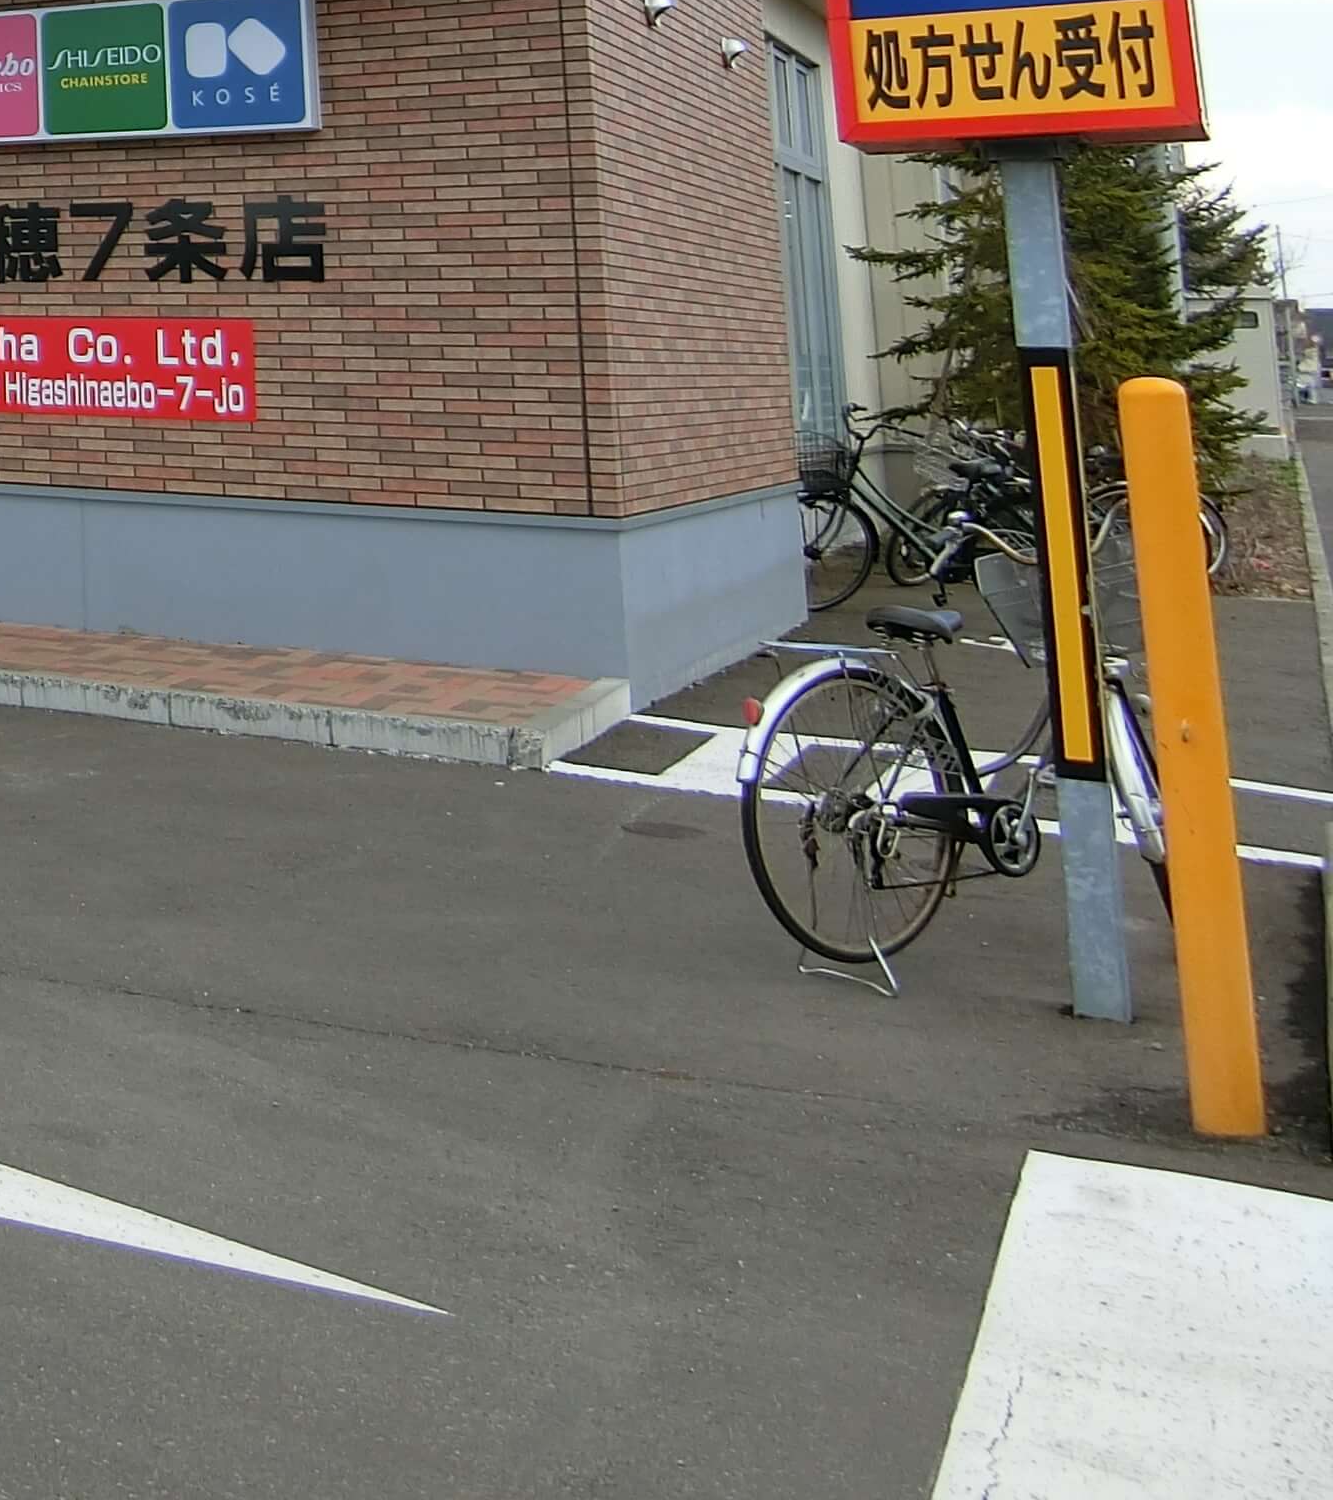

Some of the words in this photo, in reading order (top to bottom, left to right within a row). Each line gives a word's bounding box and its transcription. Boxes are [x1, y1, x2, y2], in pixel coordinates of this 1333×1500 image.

[46, 43, 162, 71] SHISEIDO
[863, 9, 1156, 112] 処方せん受付
[60, 73, 148, 89] CHAINSTORE
[192, 82, 281, 107] KOSÉ
[67, 327, 133, 365] Co.
[5, 374, 245, 414] Higashinaebo-7-jo
